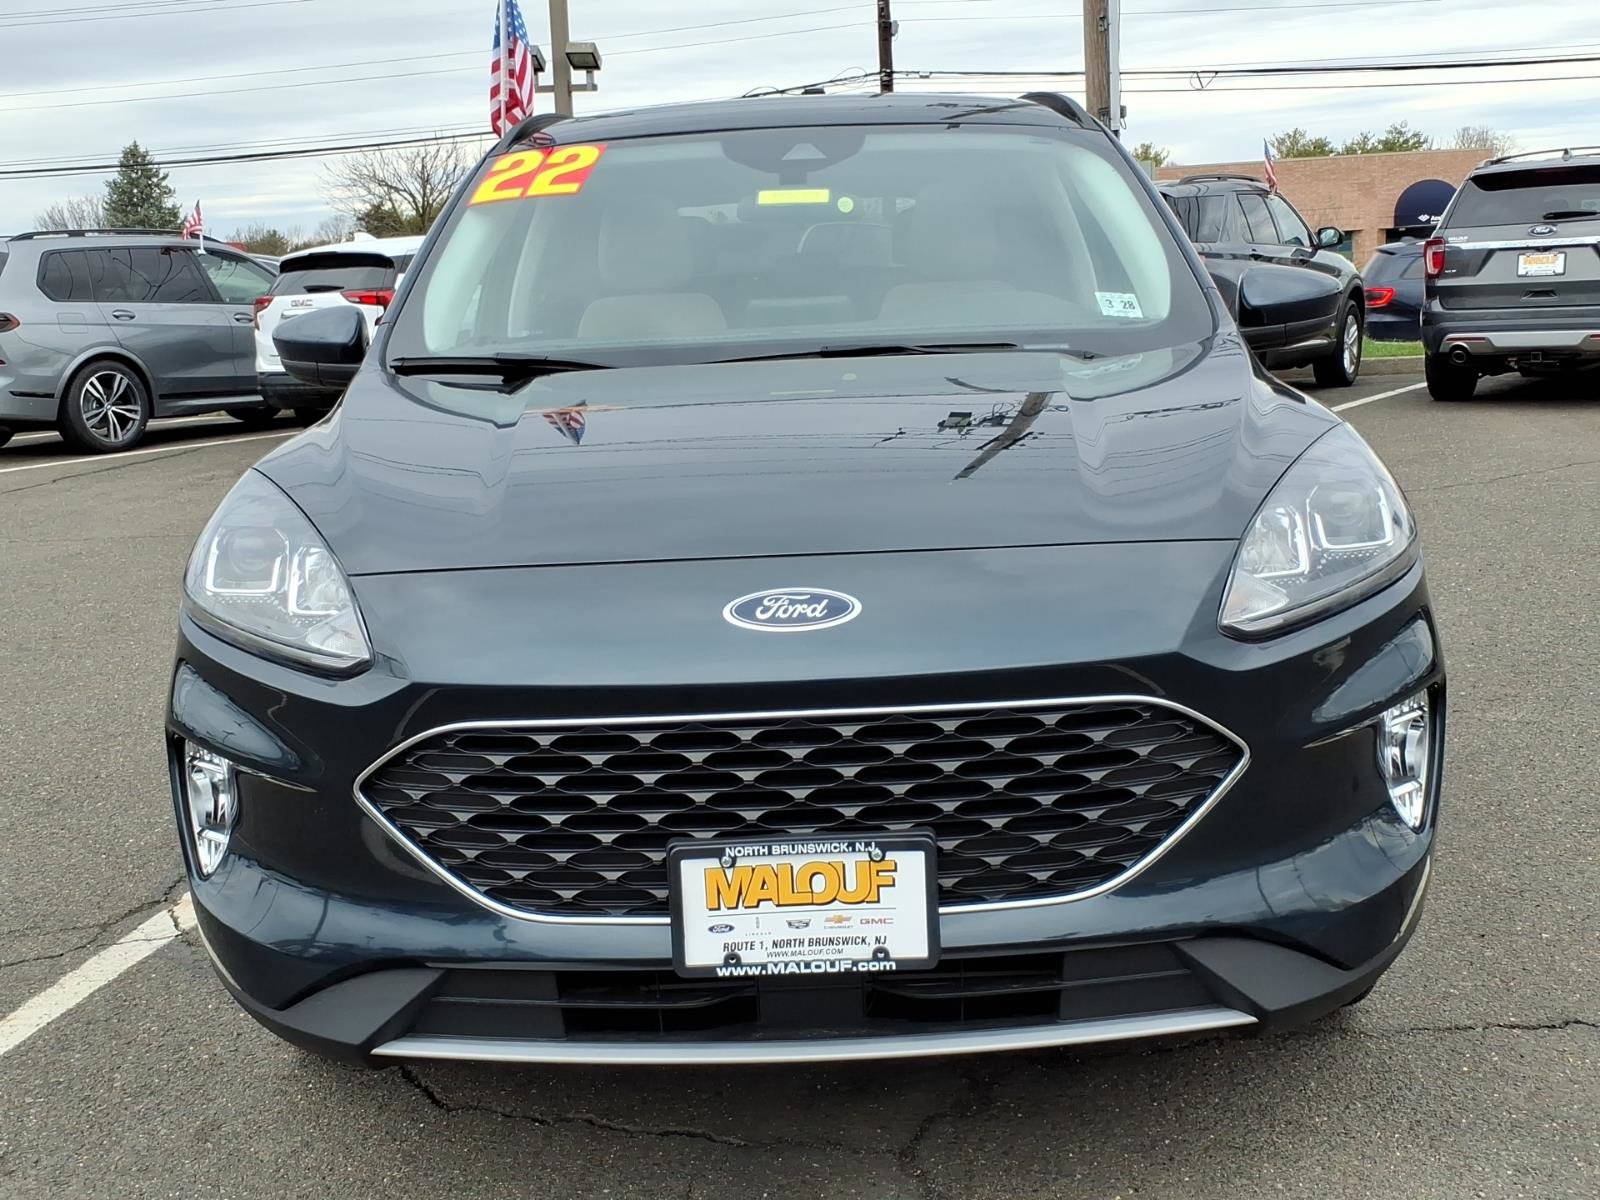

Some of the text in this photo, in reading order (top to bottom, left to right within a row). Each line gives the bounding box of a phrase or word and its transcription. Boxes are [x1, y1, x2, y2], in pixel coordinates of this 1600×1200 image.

[470, 145, 600, 204] 22
[1105, 299, 1136, 310] 3 28
[755, 595, 828, 620] Ford
[725, 844, 769, 857] NORTH
[704, 860, 897, 911] MALOUF
[860, 917, 894, 925] GMC
[723, 935, 888, 953] ROUTE 1, NORTH BRUNSWICK, NJ
[767, 948, 844, 958] WWW.MALOUF.COM
[716, 960, 897, 977] www.MALOUF.com
